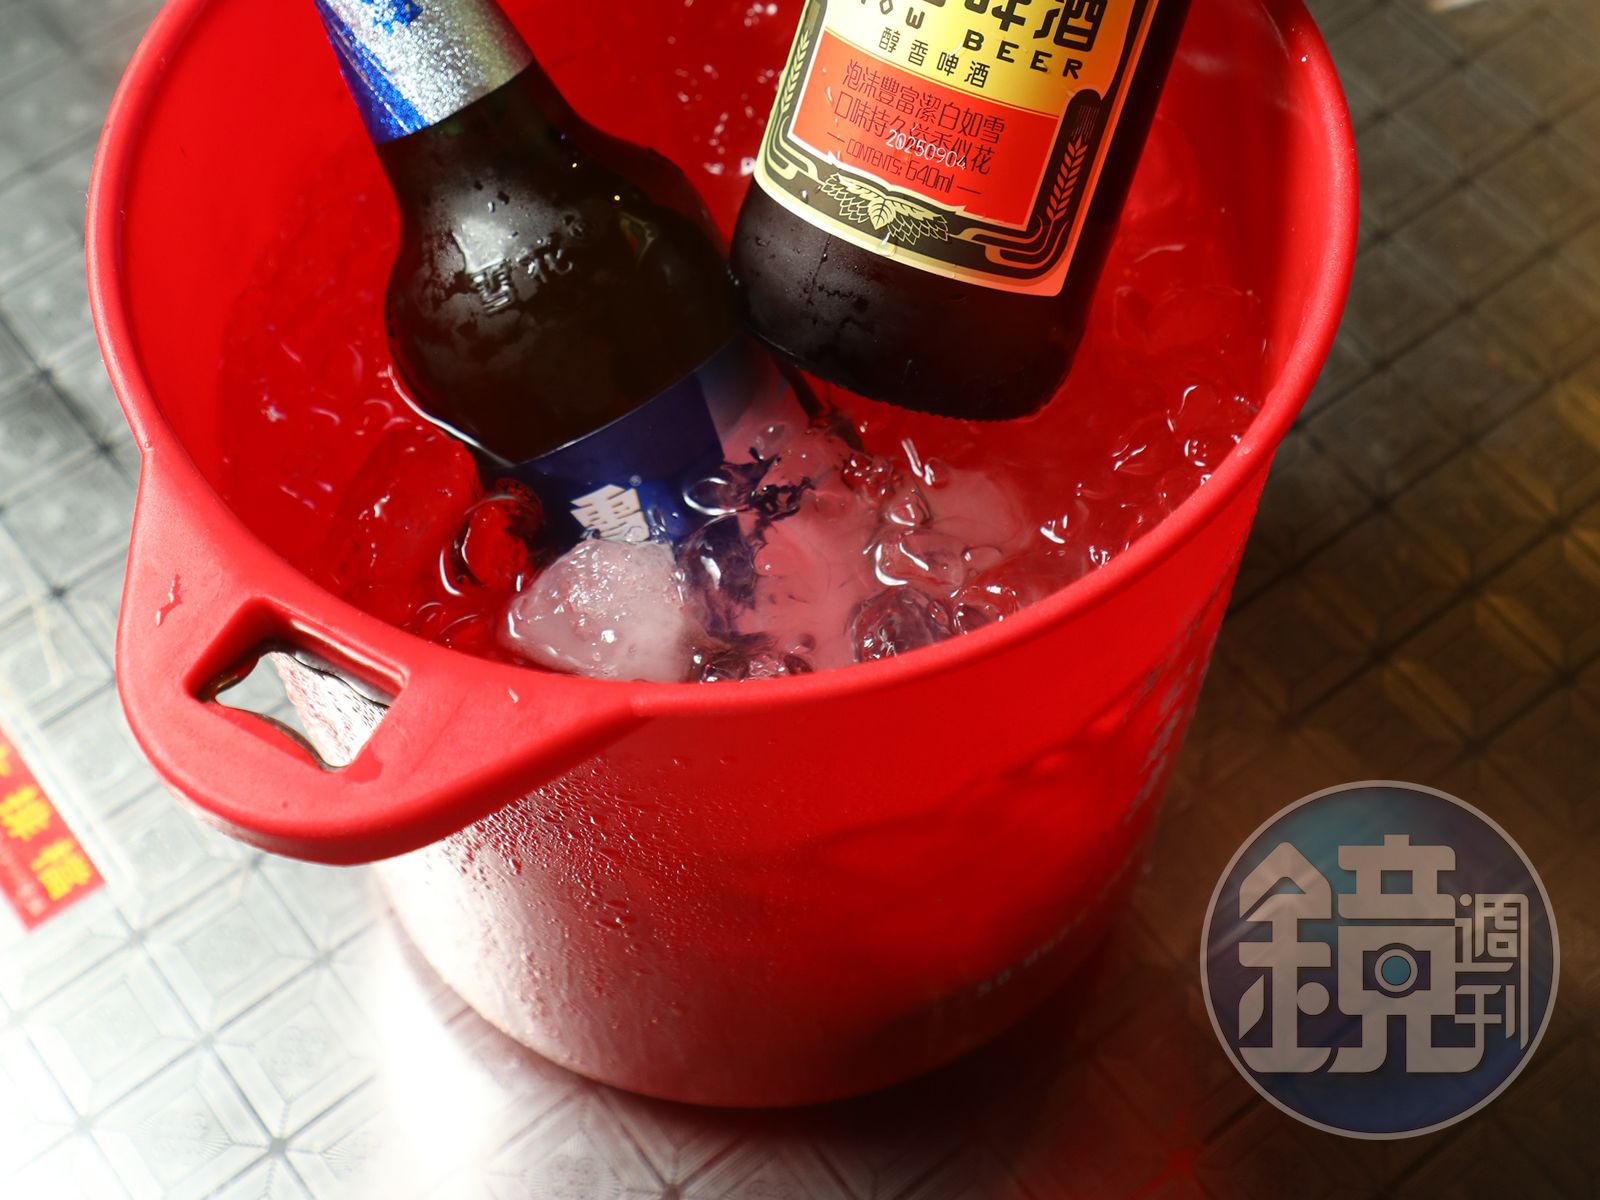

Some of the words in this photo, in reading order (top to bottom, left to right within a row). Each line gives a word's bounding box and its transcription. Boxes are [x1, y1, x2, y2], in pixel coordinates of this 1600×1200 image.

[878, 27, 991, 89] 醇香啤酒
[962, 31, 1087, 80] BEER
[842, 58, 1005, 144] 泡沫豐富潔白如雪
[846, 137, 903, 177] CONTENTS:
[905, 159, 955, 194] 640ml
[885, 128, 967, 170] 20250904
